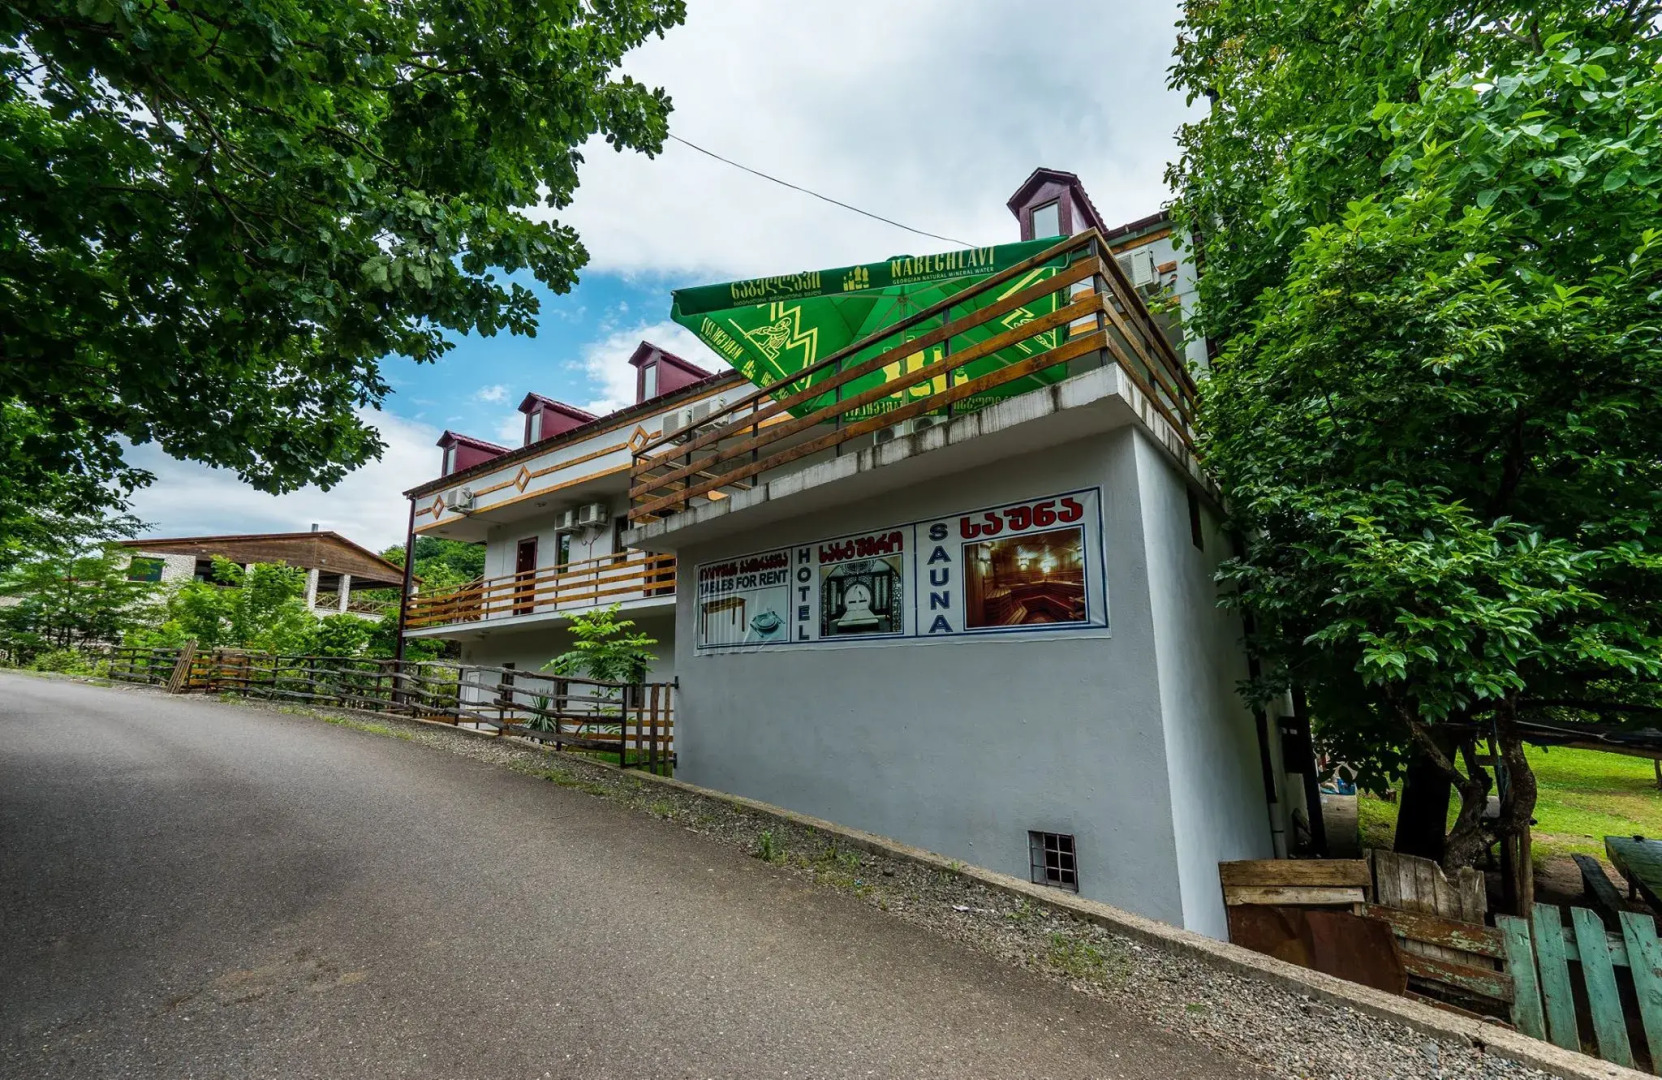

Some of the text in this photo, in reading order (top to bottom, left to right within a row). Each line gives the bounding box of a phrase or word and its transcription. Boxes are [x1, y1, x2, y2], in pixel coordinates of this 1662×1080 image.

[891, 246, 994, 278] NABEGHLAVI
[892, 266, 994, 286] GEORGIAN NATURAL MINERAL WATER
[960, 497, 1083, 539] საუნა
[736, 573, 757, 590] FOR
[759, 569, 788, 586] RENT
[797, 547, 811, 640] HOTEL
[927, 523, 953, 633] SAUNA
